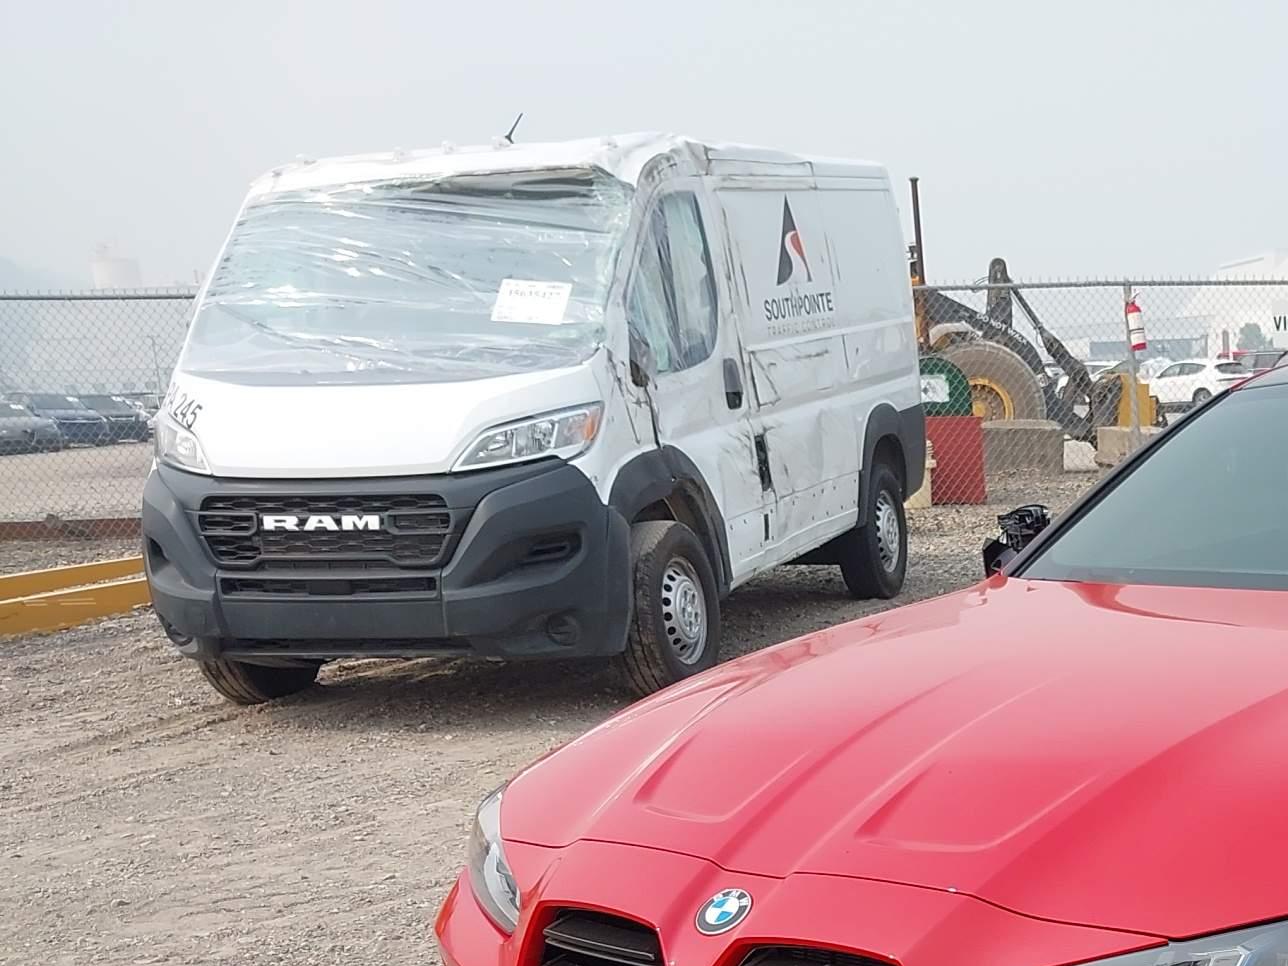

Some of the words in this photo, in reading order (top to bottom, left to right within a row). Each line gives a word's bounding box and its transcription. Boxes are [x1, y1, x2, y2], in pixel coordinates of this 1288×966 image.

[764, 292, 834, 321] SOUTHPOINTE
[989, 318, 1007, 332] NOT
[173, 393, 204, 429] 245
[262, 515, 380, 531] RAM
